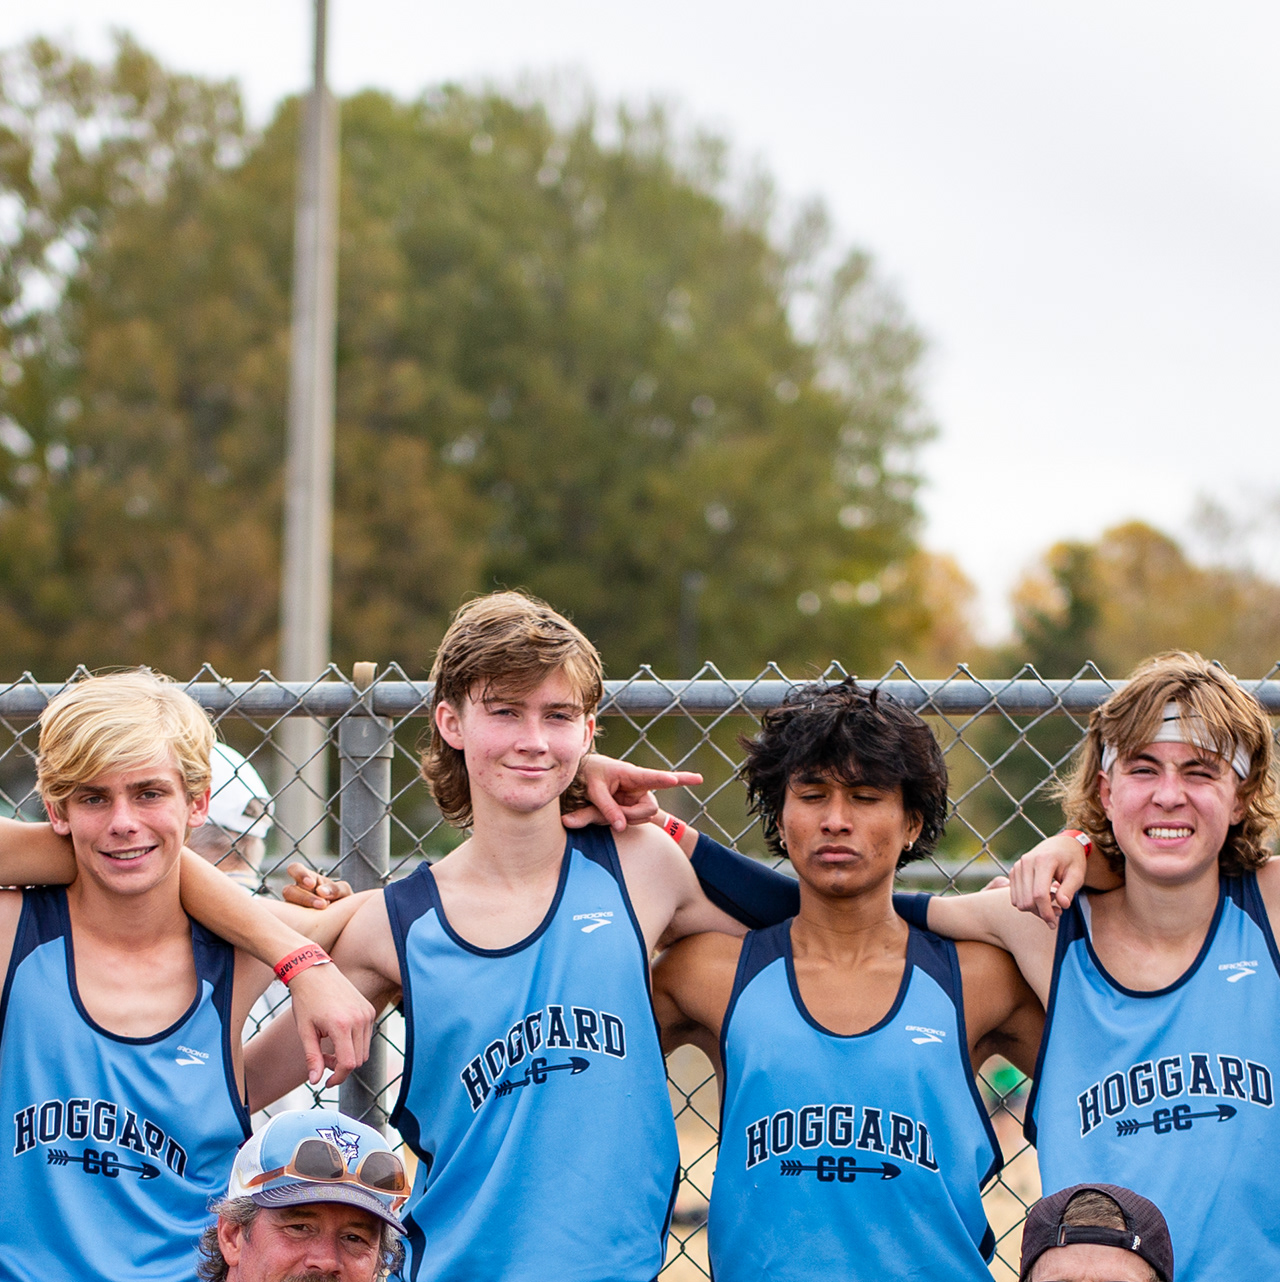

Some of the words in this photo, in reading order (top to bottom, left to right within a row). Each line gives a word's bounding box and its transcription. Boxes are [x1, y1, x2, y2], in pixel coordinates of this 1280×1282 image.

[572, 911, 614, 921] BROOKS
[1218, 960, 1258, 971] BROOKS
[905, 1025, 946, 1037] BROOKS
[1077, 1052, 1275, 1139] HOGGARD
[1153, 1104, 1193, 1135] CC
[83, 1148, 119, 1178] CC
[817, 1156, 856, 1183] CC
